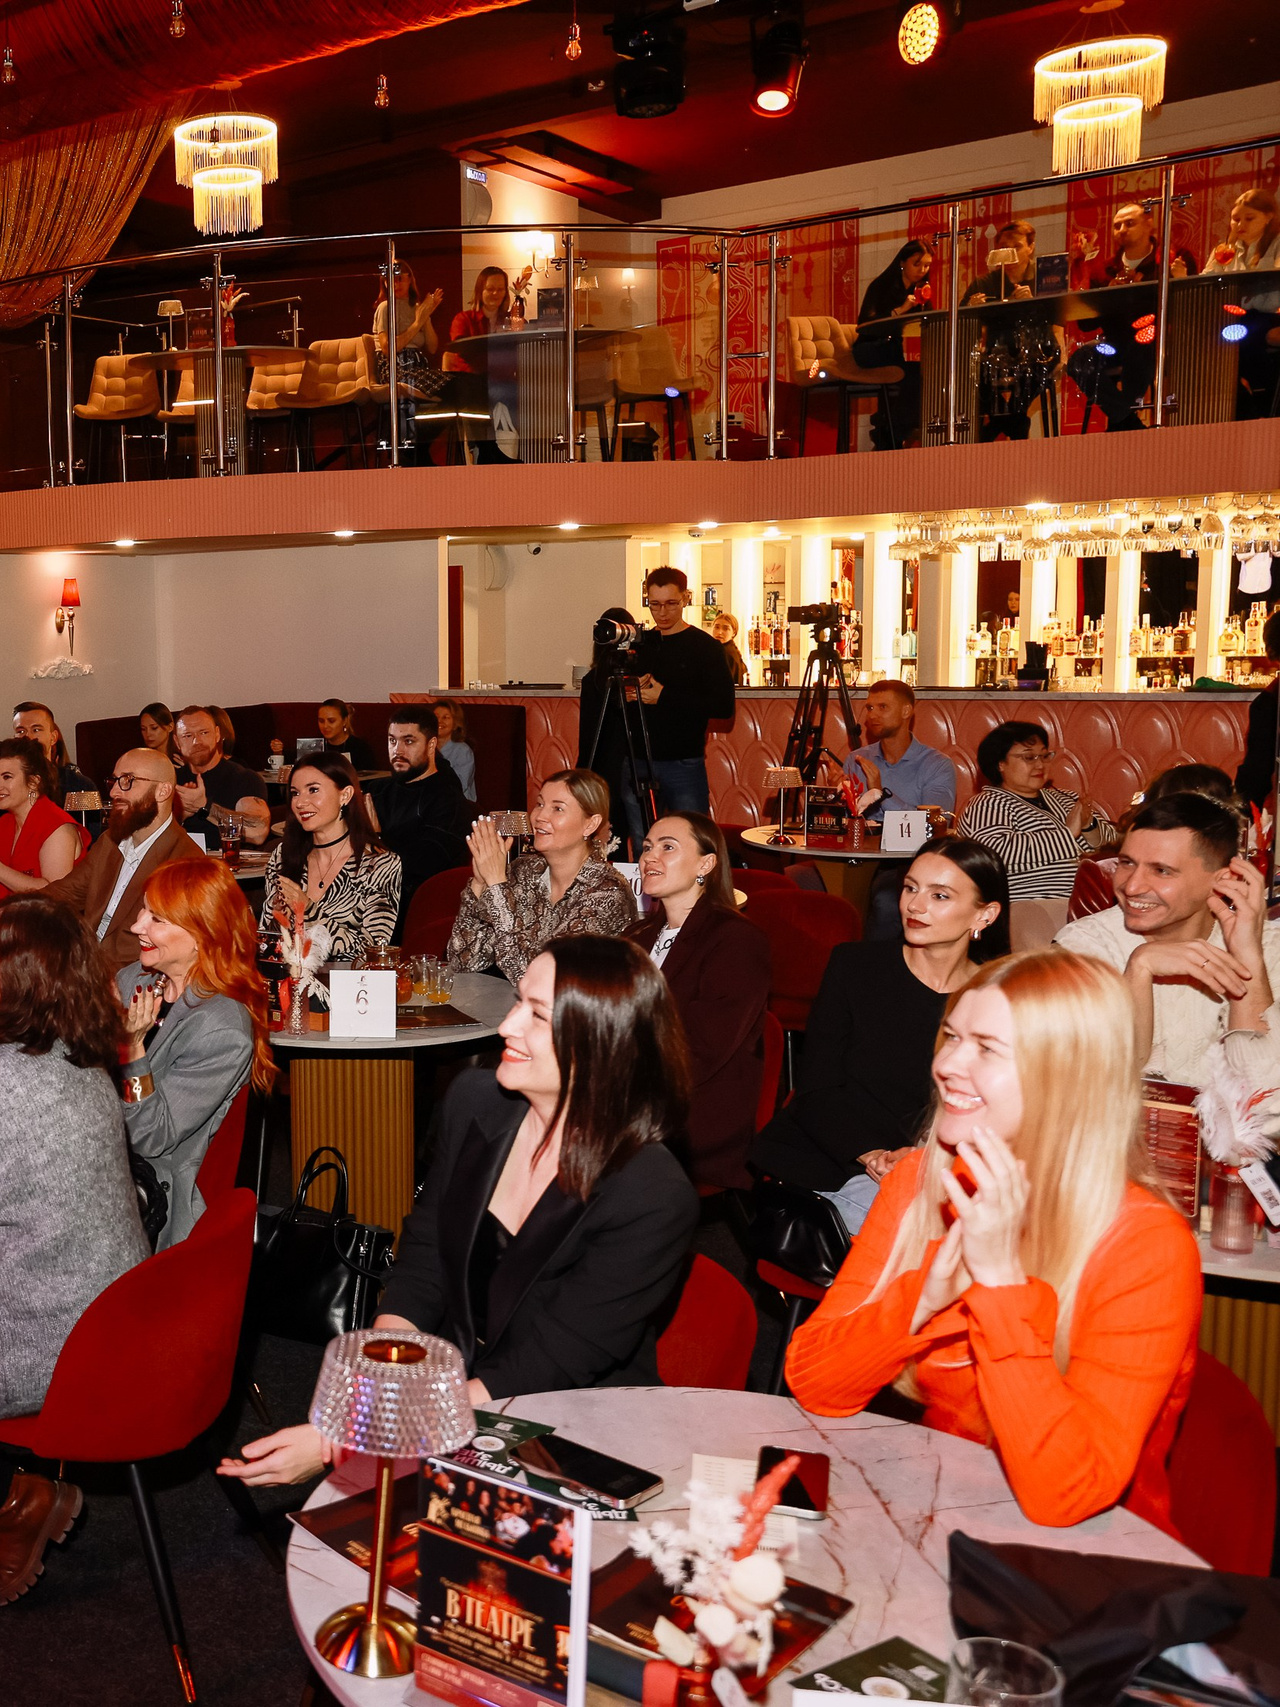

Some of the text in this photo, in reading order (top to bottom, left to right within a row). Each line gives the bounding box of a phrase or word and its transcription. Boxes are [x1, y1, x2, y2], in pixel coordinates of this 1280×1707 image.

[899, 822, 912, 838] 14
[356, 989, 369, 1015] 6
[446, 1588, 461, 1618] В
[462, 1594, 537, 1651] ТЕАТРЕ
